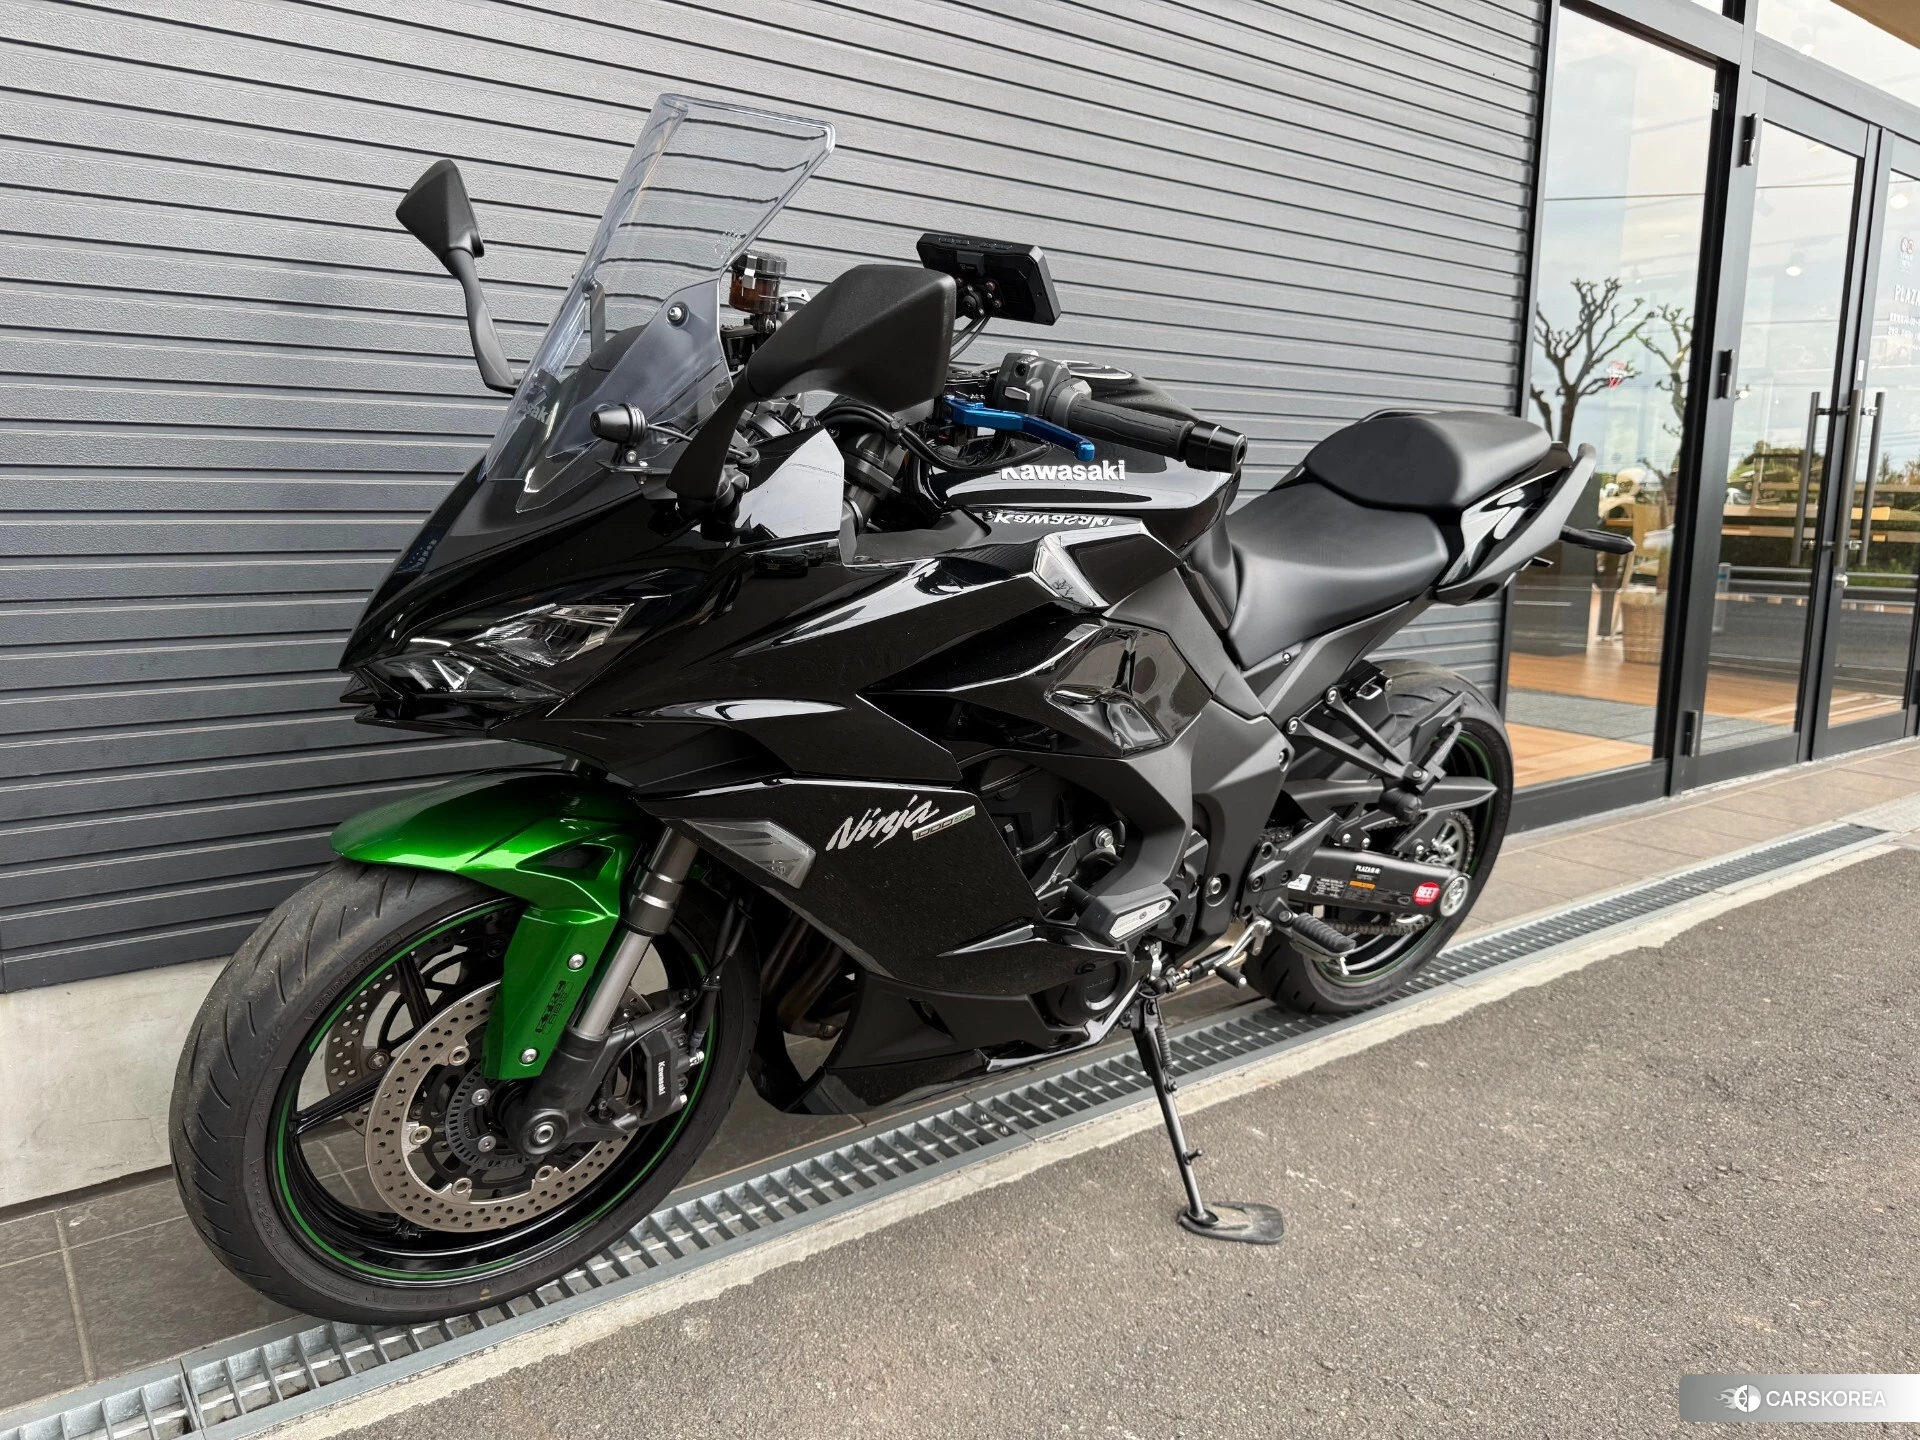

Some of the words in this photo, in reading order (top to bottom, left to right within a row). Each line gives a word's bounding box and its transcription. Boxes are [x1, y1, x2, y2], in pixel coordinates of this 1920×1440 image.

[1001, 459, 1126, 481] Kawasaki
[825, 794, 940, 851] Ninja
[657, 1060, 666, 1096] Kawasaki
